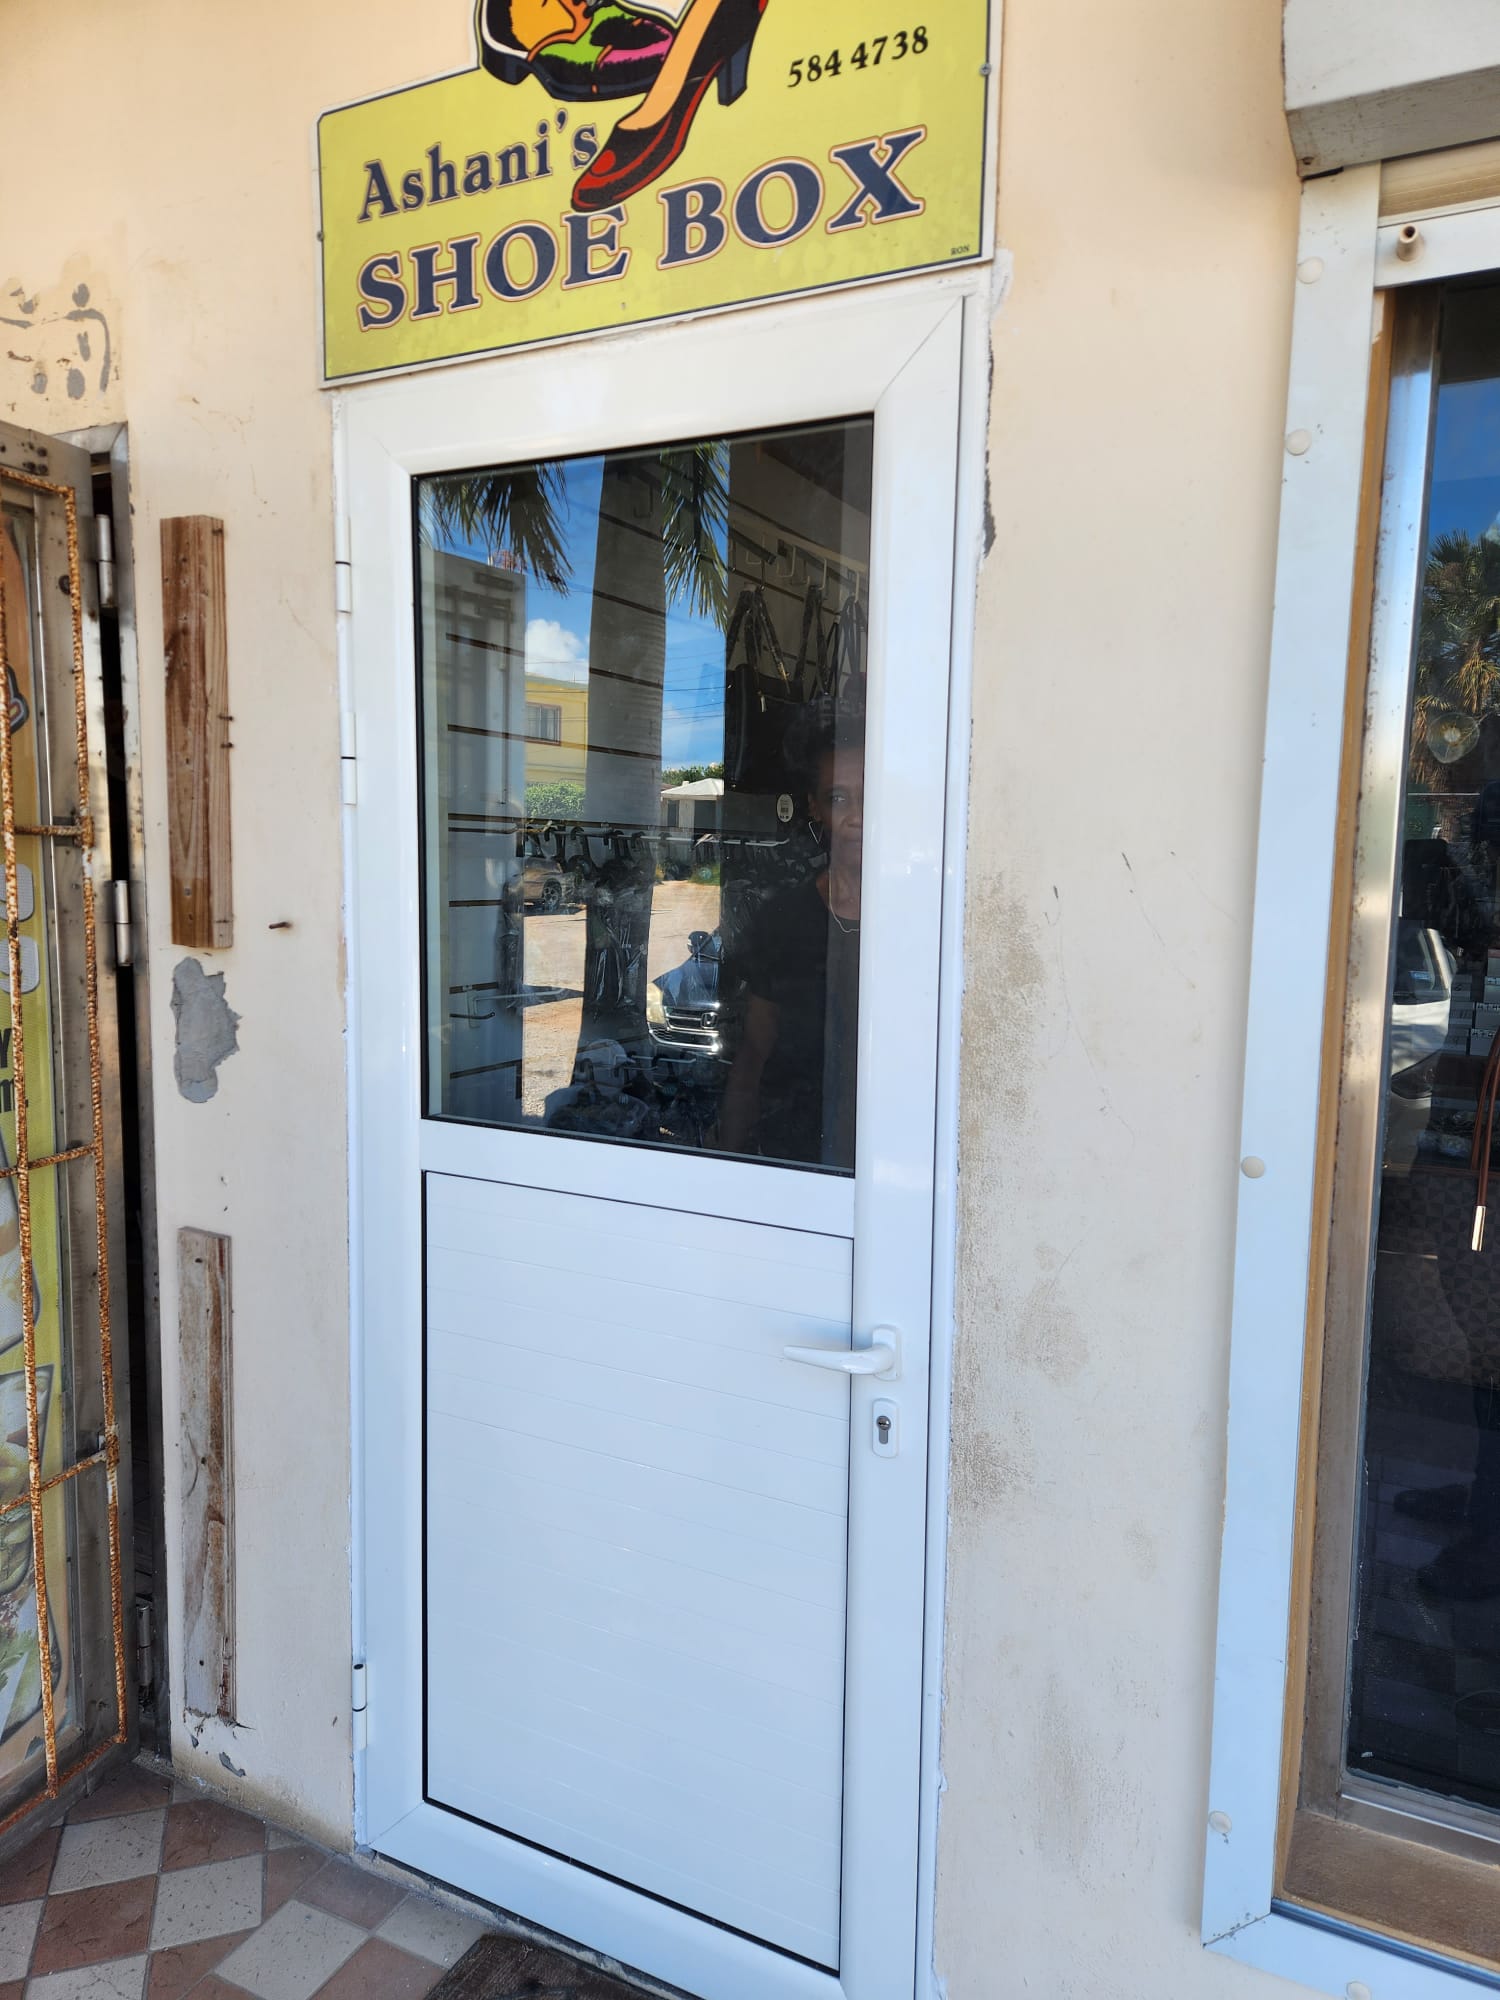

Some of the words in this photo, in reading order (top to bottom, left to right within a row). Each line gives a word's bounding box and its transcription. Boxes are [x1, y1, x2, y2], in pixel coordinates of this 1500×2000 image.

[787, 48, 842, 88] 584
[850, 25, 929, 72] 4738
[357, 108, 600, 222] Ashani's
[357, 204, 632, 331] SHOE
[656, 125, 927, 270] BOX
